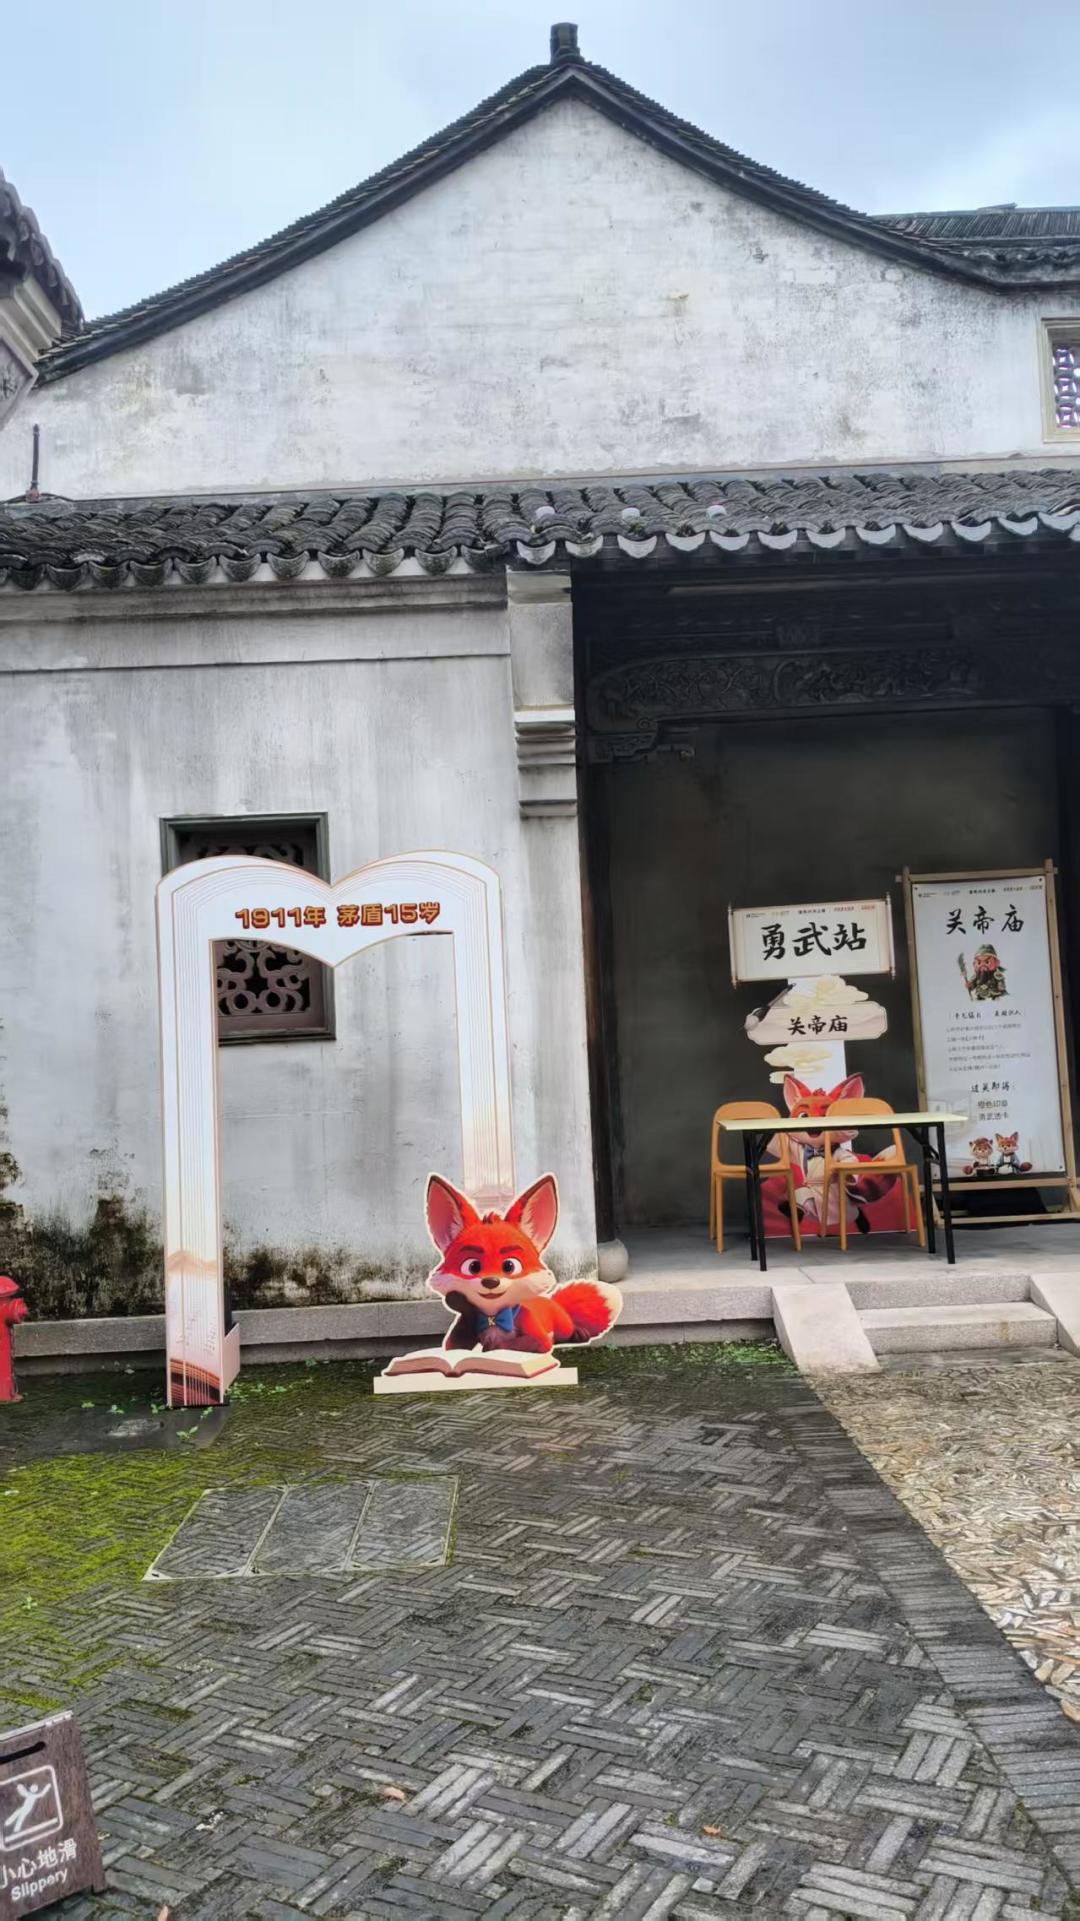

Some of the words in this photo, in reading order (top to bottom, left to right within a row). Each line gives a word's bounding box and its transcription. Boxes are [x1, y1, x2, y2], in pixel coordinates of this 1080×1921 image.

[235, 906, 326, 929] 1911年
[337, 902, 441, 926] 茅盾15岁
[946, 904, 1025, 935] 关帝庙
[760, 921, 867, 961] 勇武站
[787, 1014, 849, 1036] 关帝庙
[0, 1837, 78, 1889] 小心地滑
[11, 1867, 69, 1902] Slippery
